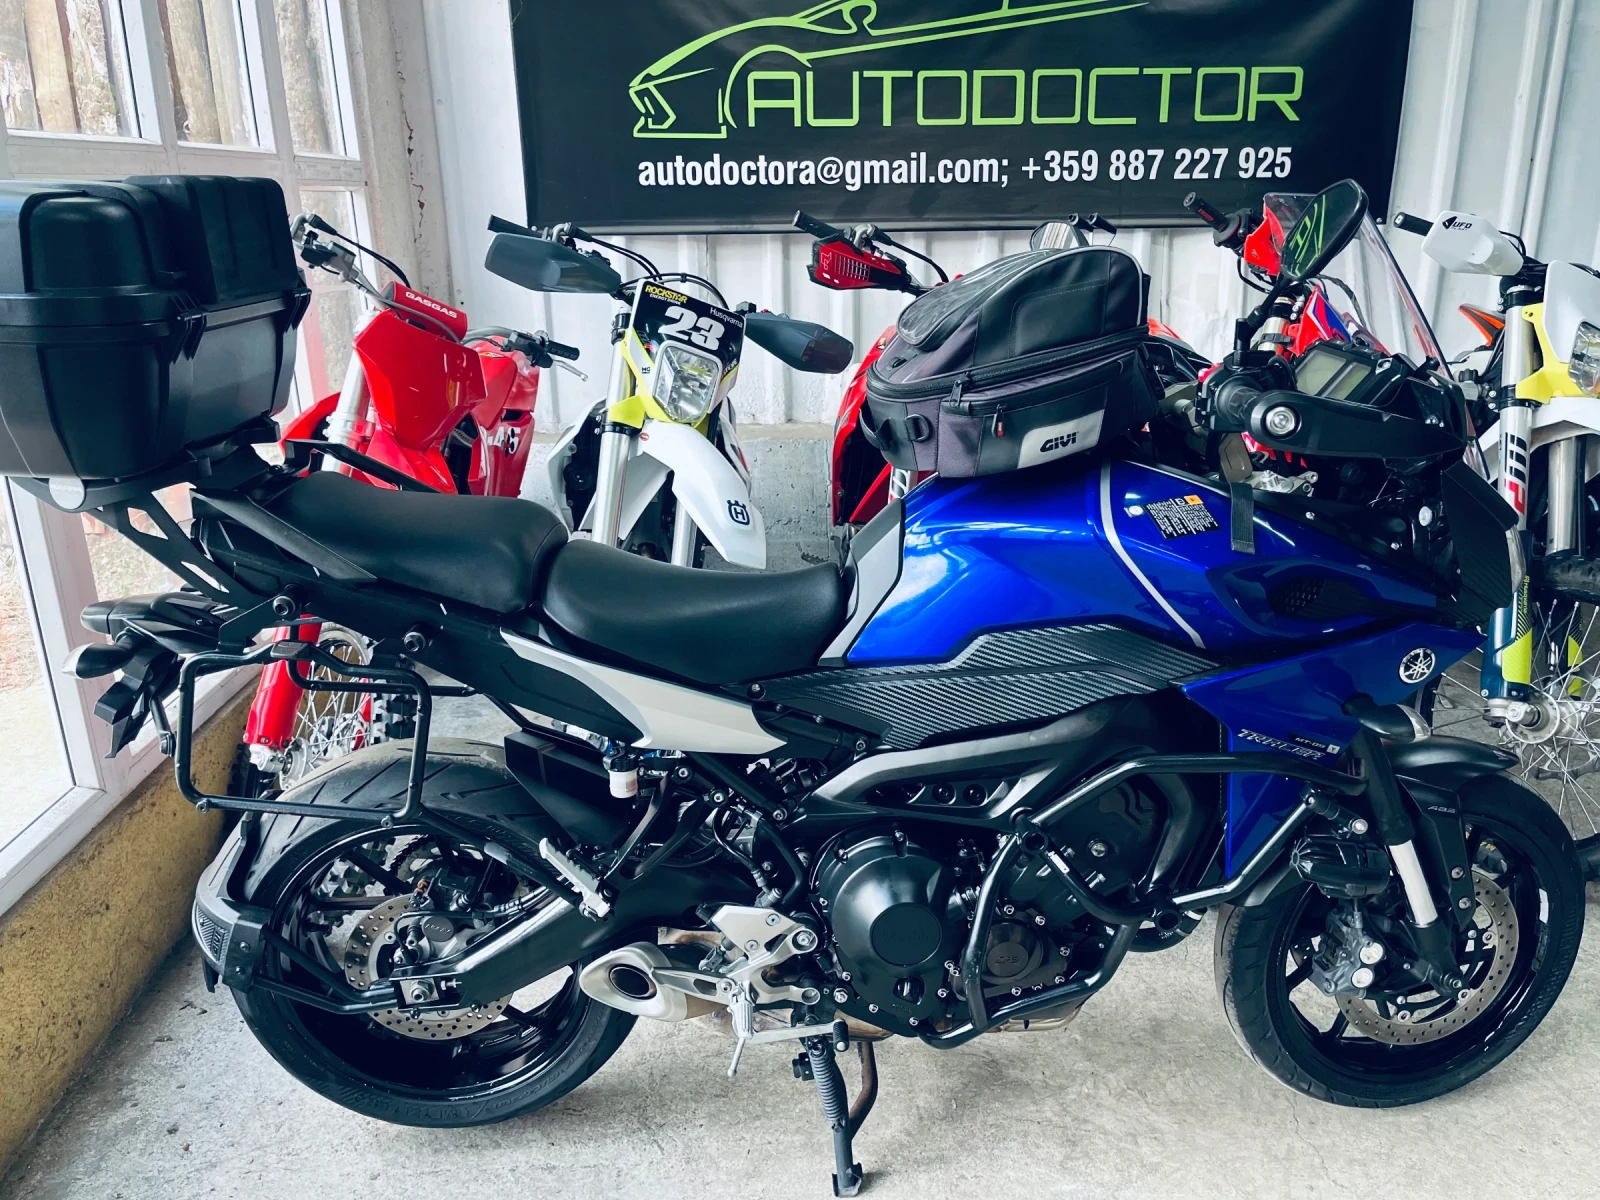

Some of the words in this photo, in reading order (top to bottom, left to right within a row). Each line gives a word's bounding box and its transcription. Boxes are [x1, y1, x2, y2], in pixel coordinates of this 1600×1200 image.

[747, 66, 1304, 128] AUTODOCTOR
[638, 151, 1009, 191] autodoctora@gmail.com;
[1021, 149, 1099, 182] +359
[1109, 148, 1165, 181] 887
[1173, 147, 1229, 179] 227
[1238, 146, 1292, 178] 925
[1452, 221, 1473, 229] UFO
[405, 291, 458, 319] GASGAS
[709, 306, 743, 328] Husqvarna
[657, 305, 725, 351] 23
[1039, 431, 1078, 453] GIVI
